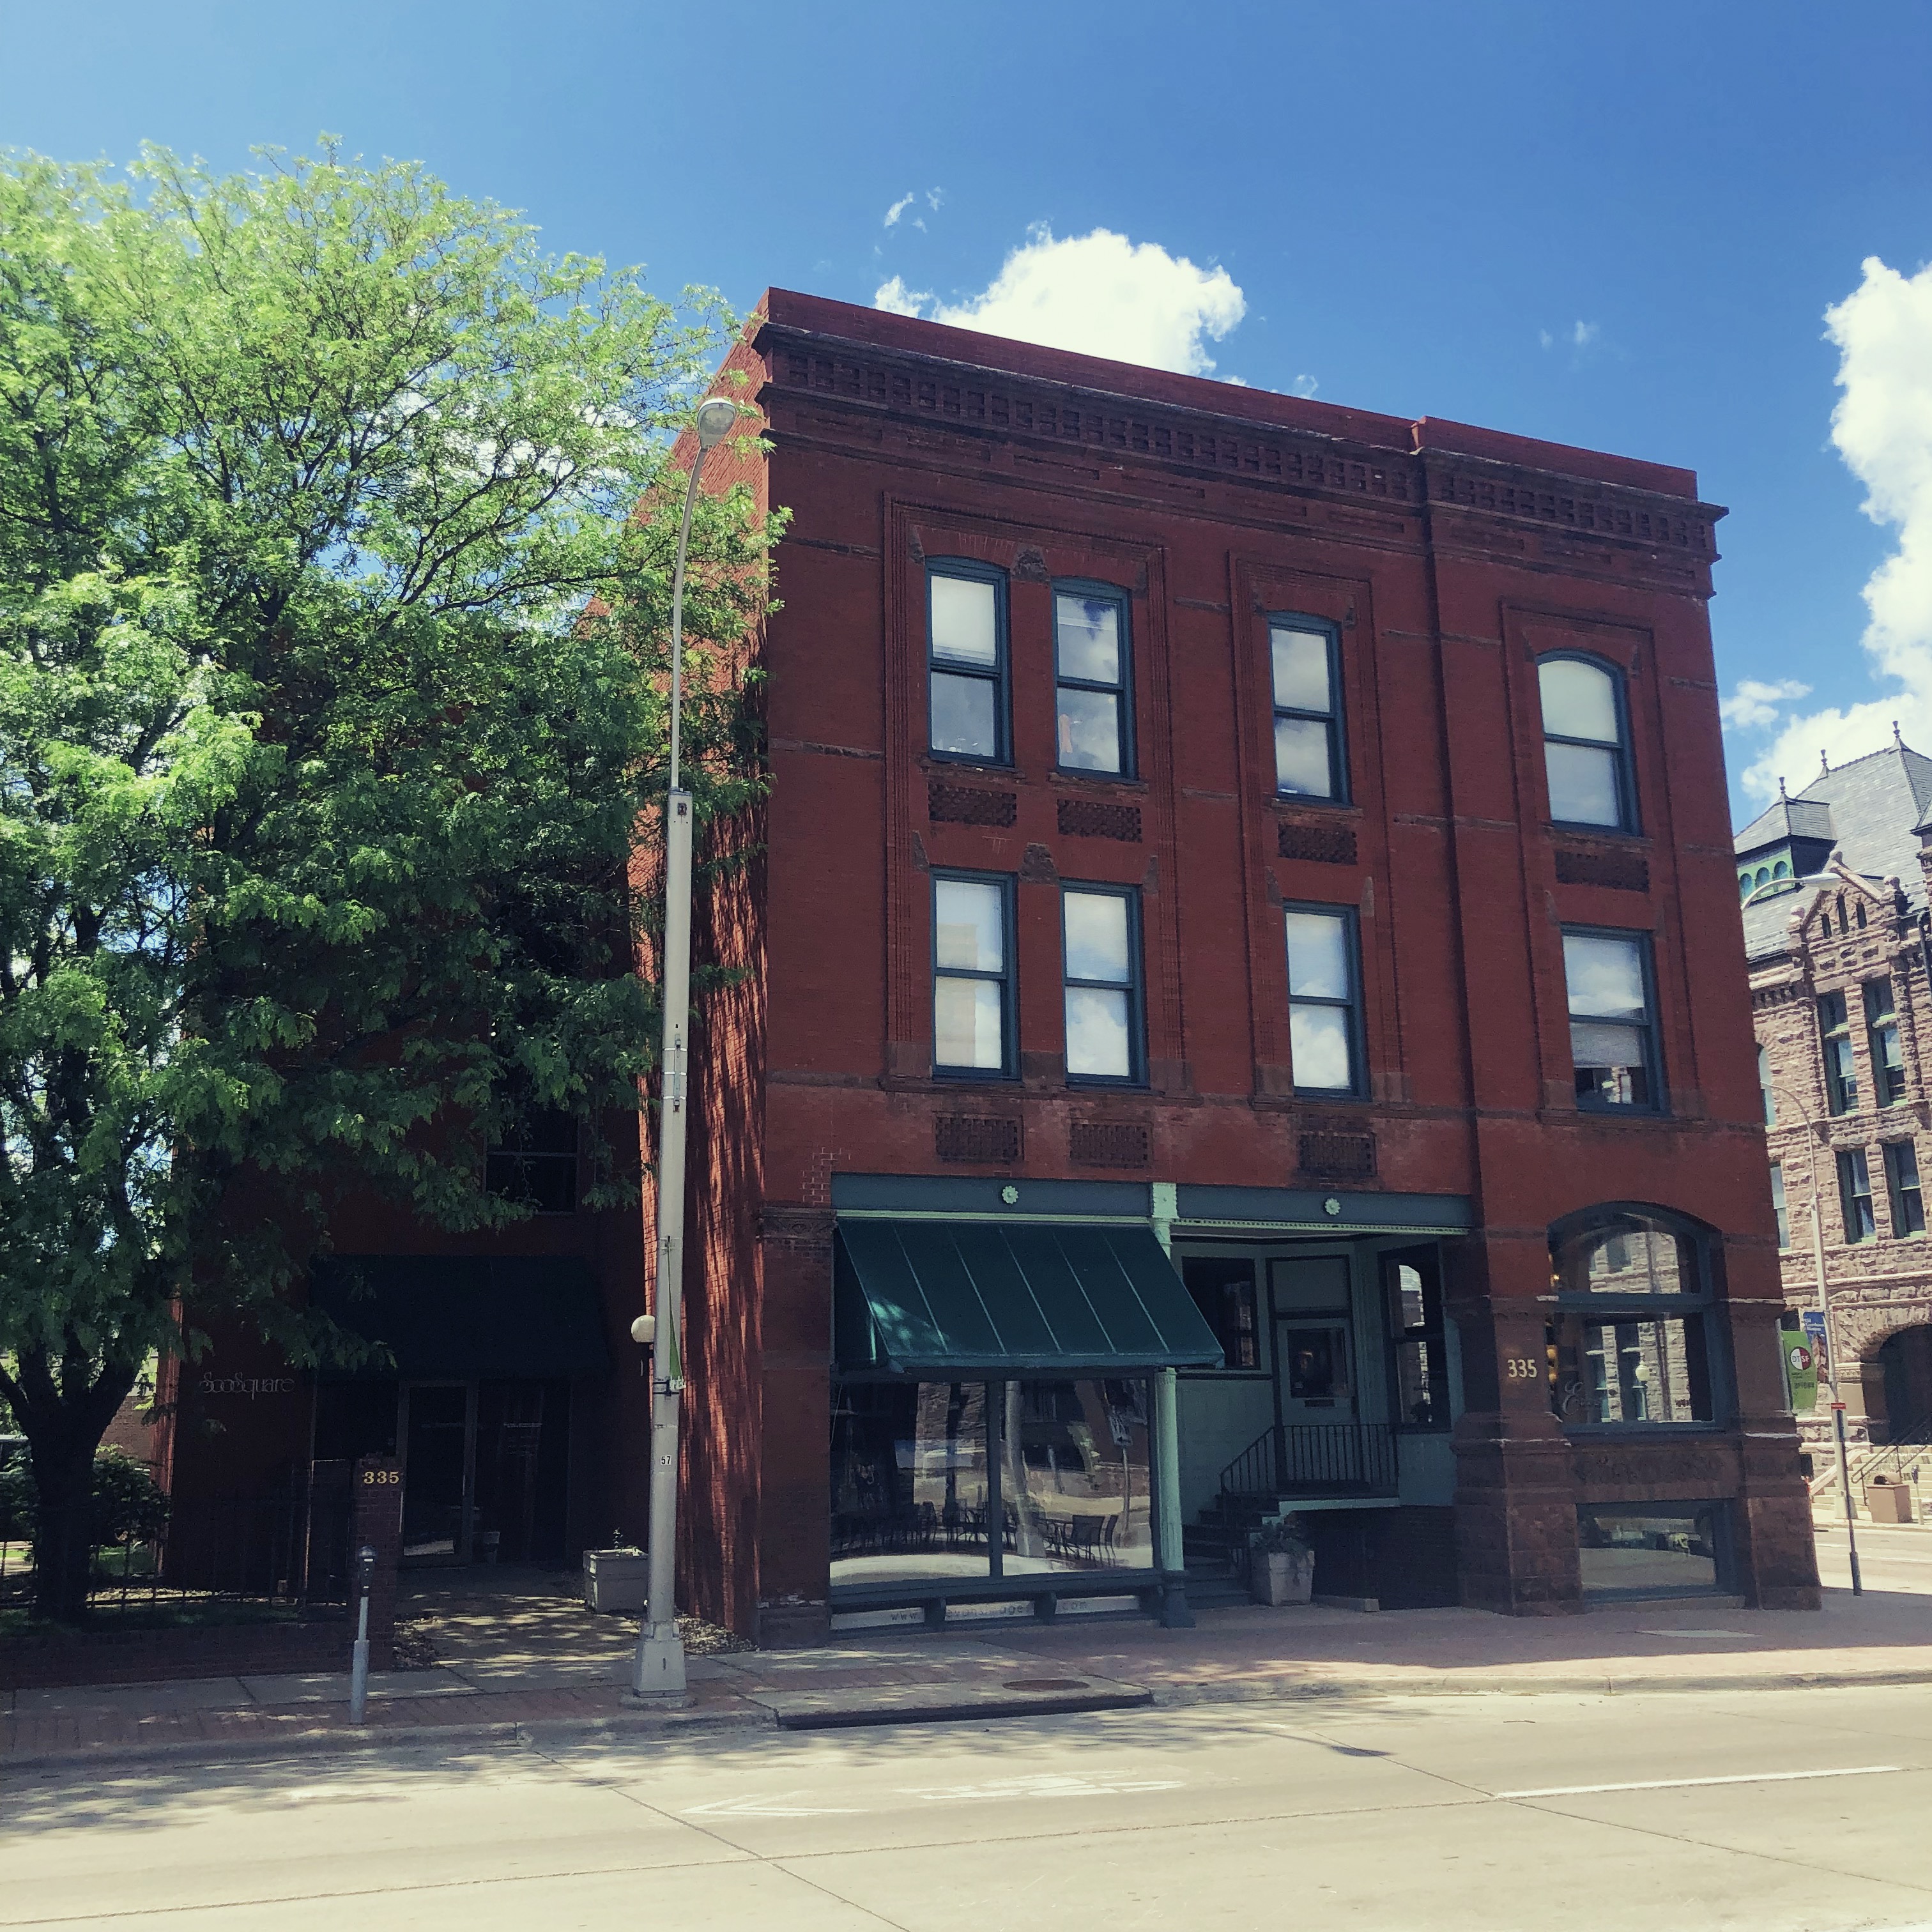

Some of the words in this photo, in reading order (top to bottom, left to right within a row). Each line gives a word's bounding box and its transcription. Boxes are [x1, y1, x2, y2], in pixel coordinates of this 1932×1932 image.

[1507, 1358, 1538, 1378] 335
[661, 1455, 671, 1465] 57
[364, 1471, 399, 1484] 335
